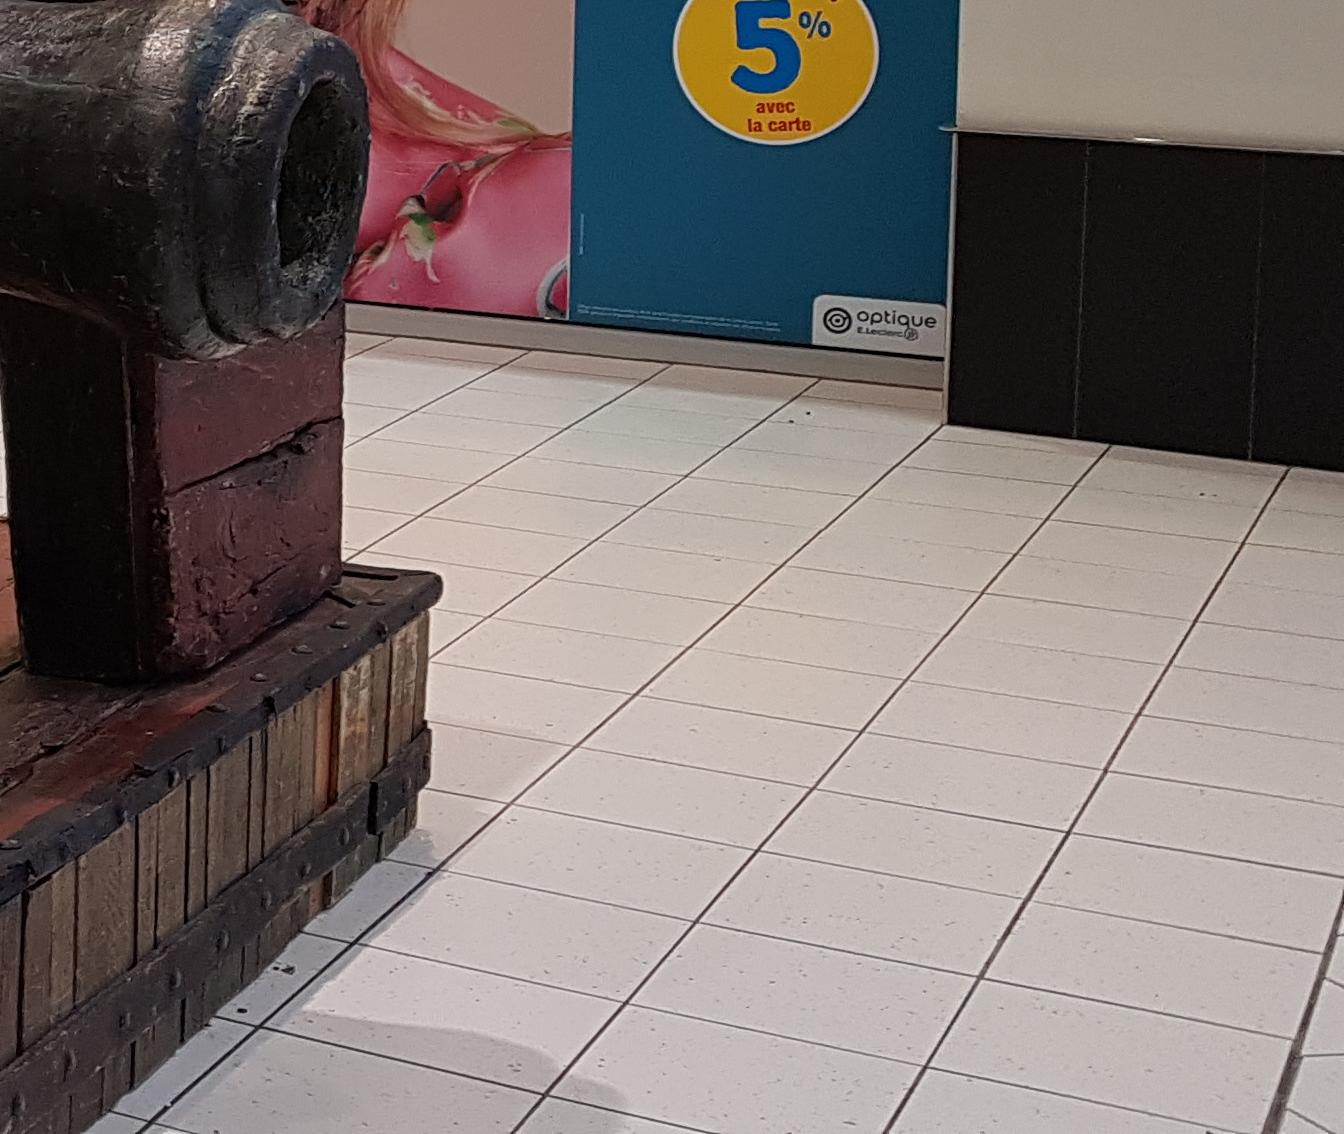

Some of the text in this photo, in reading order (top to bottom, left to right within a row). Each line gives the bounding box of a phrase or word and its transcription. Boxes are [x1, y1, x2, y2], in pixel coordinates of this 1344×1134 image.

[756, 100, 796, 115] avec
[747, 118, 811, 132] la carte
[857, 310, 937, 328] optique
